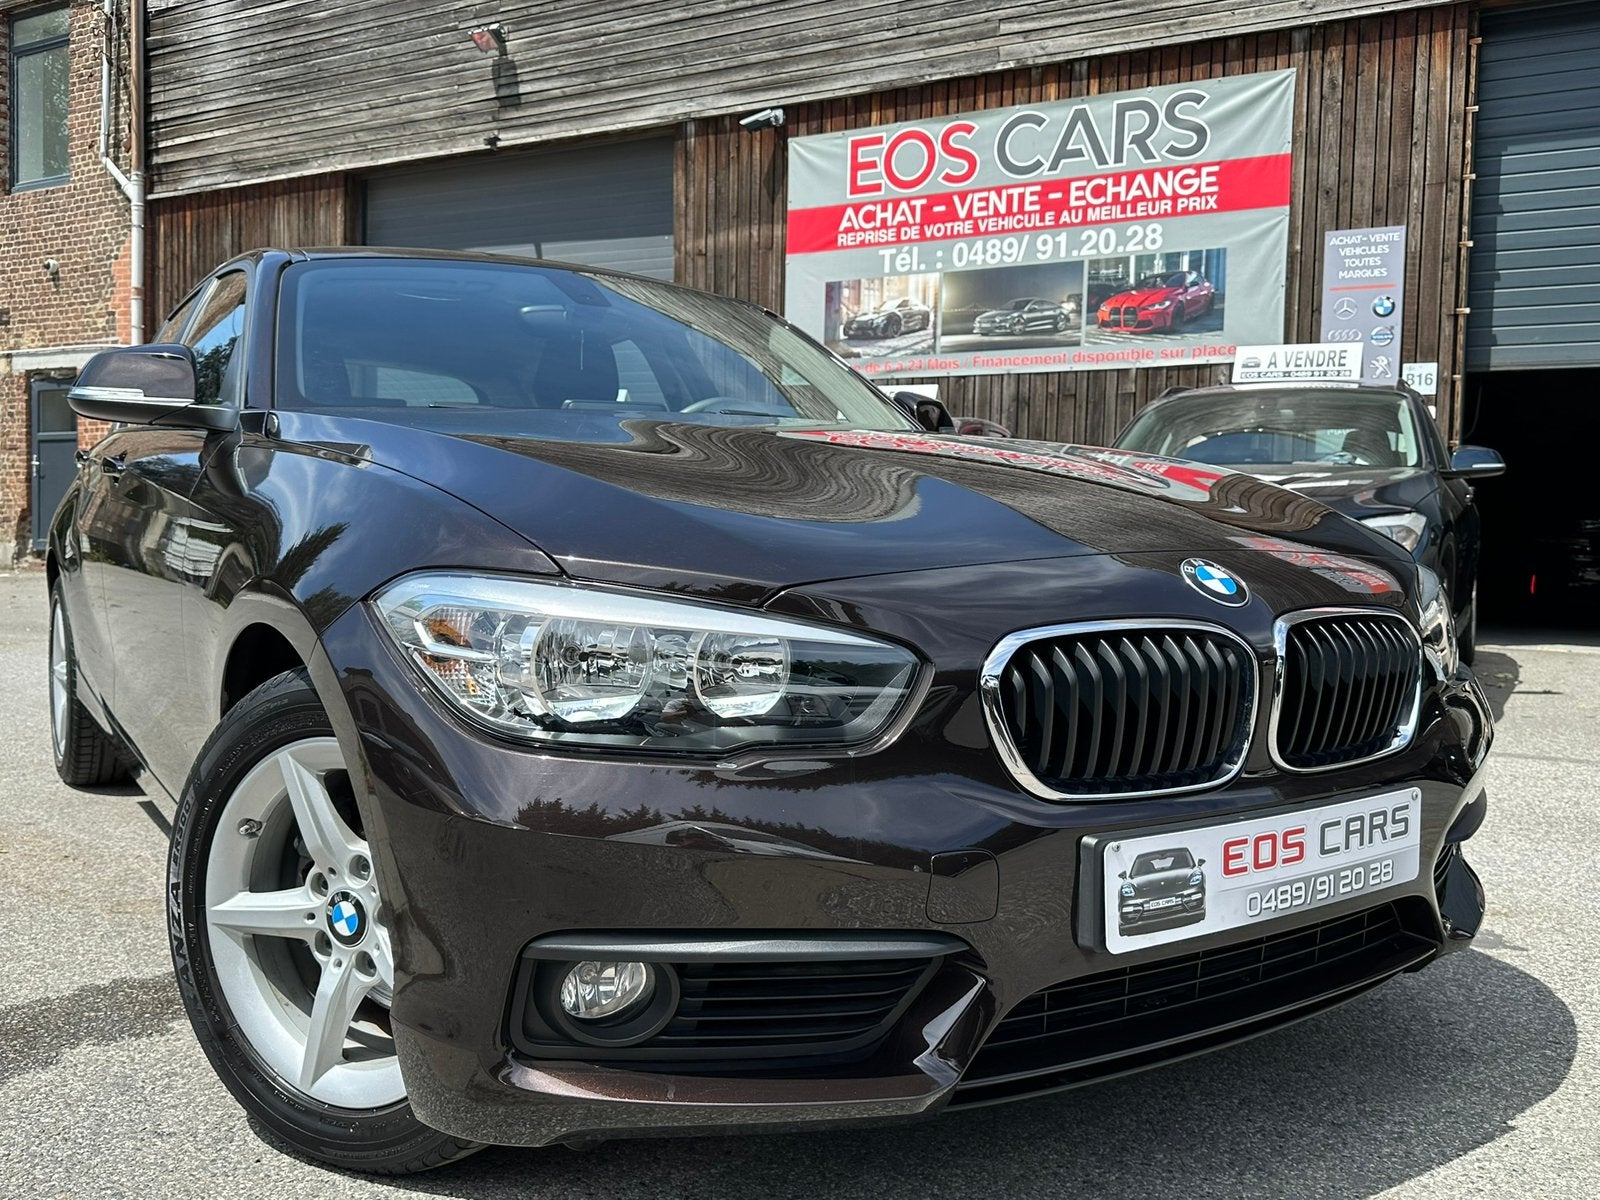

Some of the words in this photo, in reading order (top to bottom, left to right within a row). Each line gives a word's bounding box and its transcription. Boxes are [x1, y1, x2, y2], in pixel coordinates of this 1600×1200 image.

[847, 121, 980, 198] EOS
[994, 89, 1211, 179] CARS
[838, 199, 928, 232] ACHAT
[953, 185, 1042, 219] VENTE
[1069, 165, 1220, 207] ECHANGE
[837, 228, 897, 247] REPRISE
[901, 226, 921, 241] DE
[924, 221, 974, 238] VOTRE
[978, 211, 1055, 233] VEHICULE
[1059, 209, 1083, 225] AU
[1087, 200, 1172, 222] MEILLEUR
[1177, 195, 1219, 212] PRIX
[879, 246, 926, 274] Tél.
[952, 235, 1030, 267] 0489/
[1036, 223, 1164, 260] 91.20.28
[1339, 245, 1390, 256] VEHICULES
[1369, 232, 1401, 243] VENTE
[1339, 268, 1388, 279] MARQUES
[1344, 257, 1382, 267] TOUTES
[927, 358, 960, 371] Mois
[973, 351, 1068, 369] Financement
[1072, 348, 1155, 369] disponible
[1160, 346, 1186, 359] sur
[1192, 343, 1237, 363] place
[1267, 351, 1278, 369] A
[1284, 349, 1348, 368] VENDRE
[1406, 373, 1433, 386] 816
[1222, 826, 1306, 877] EOS
[1318, 803, 1410, 857] CARS
[1246, 874, 1335, 917] 0489/91
[1340, 867, 1365, 894] 20
[1369, 859, 1394, 886] 28
